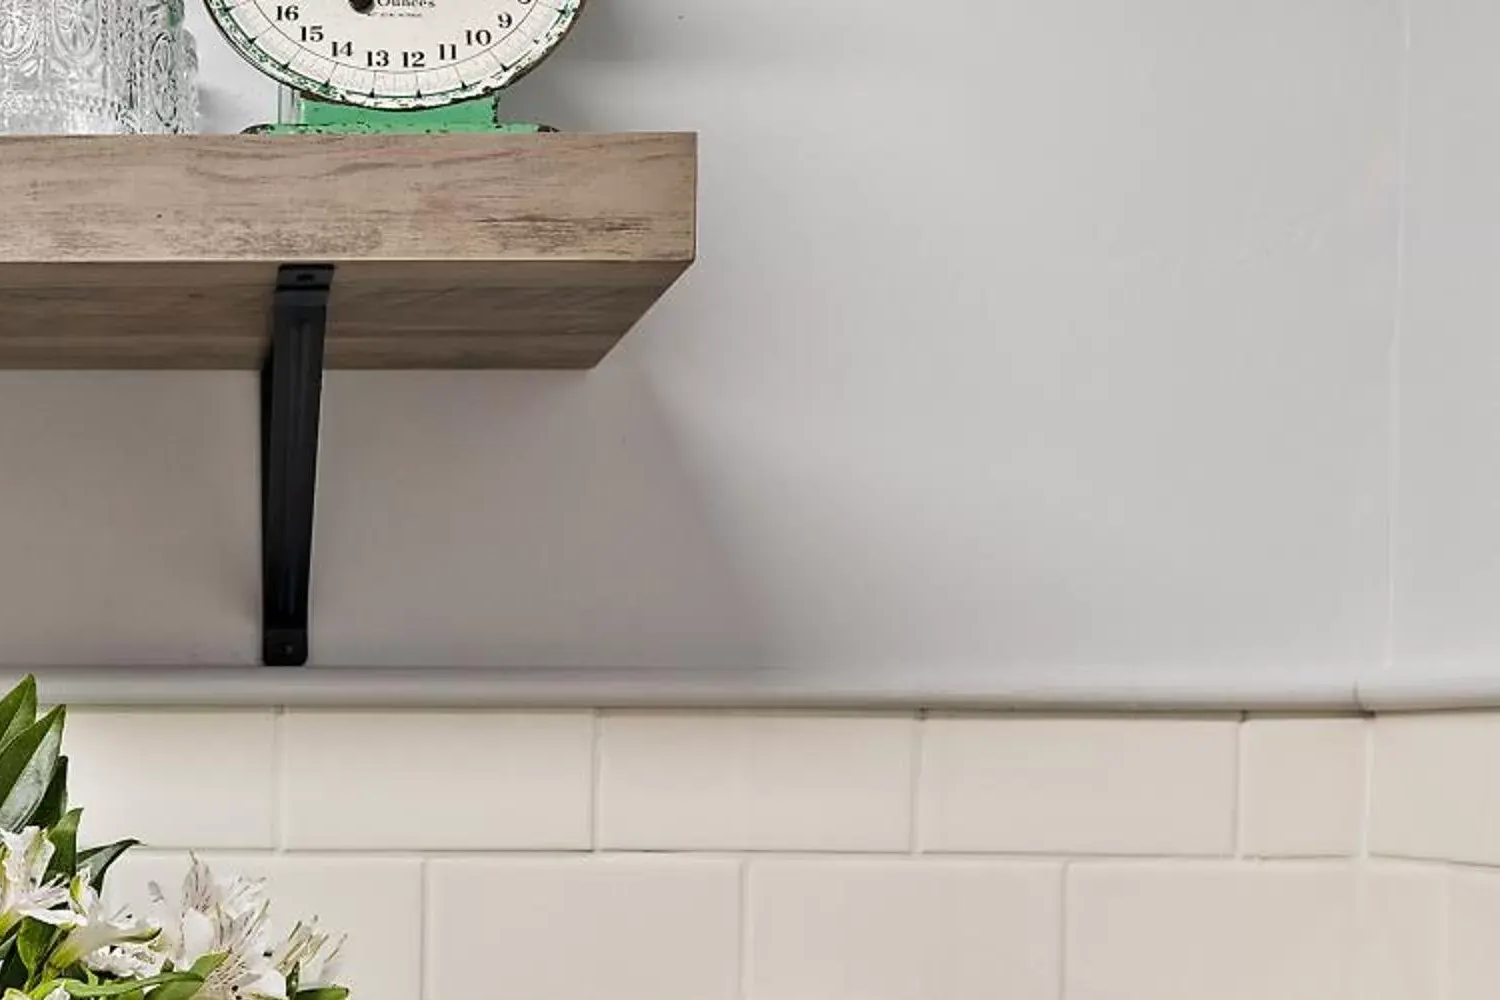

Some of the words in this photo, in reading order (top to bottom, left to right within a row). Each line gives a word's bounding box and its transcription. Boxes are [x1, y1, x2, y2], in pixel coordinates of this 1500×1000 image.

[276, 5, 299, 21] 16
[497, 12, 512, 28] 9
[300, 25, 324, 42] 15
[466, 29, 492, 46] 10
[331, 41, 353, 57] 14
[438, 43, 458, 60] 11
[366, 50, 390, 67] 13
[402, 51, 425, 67] 12
